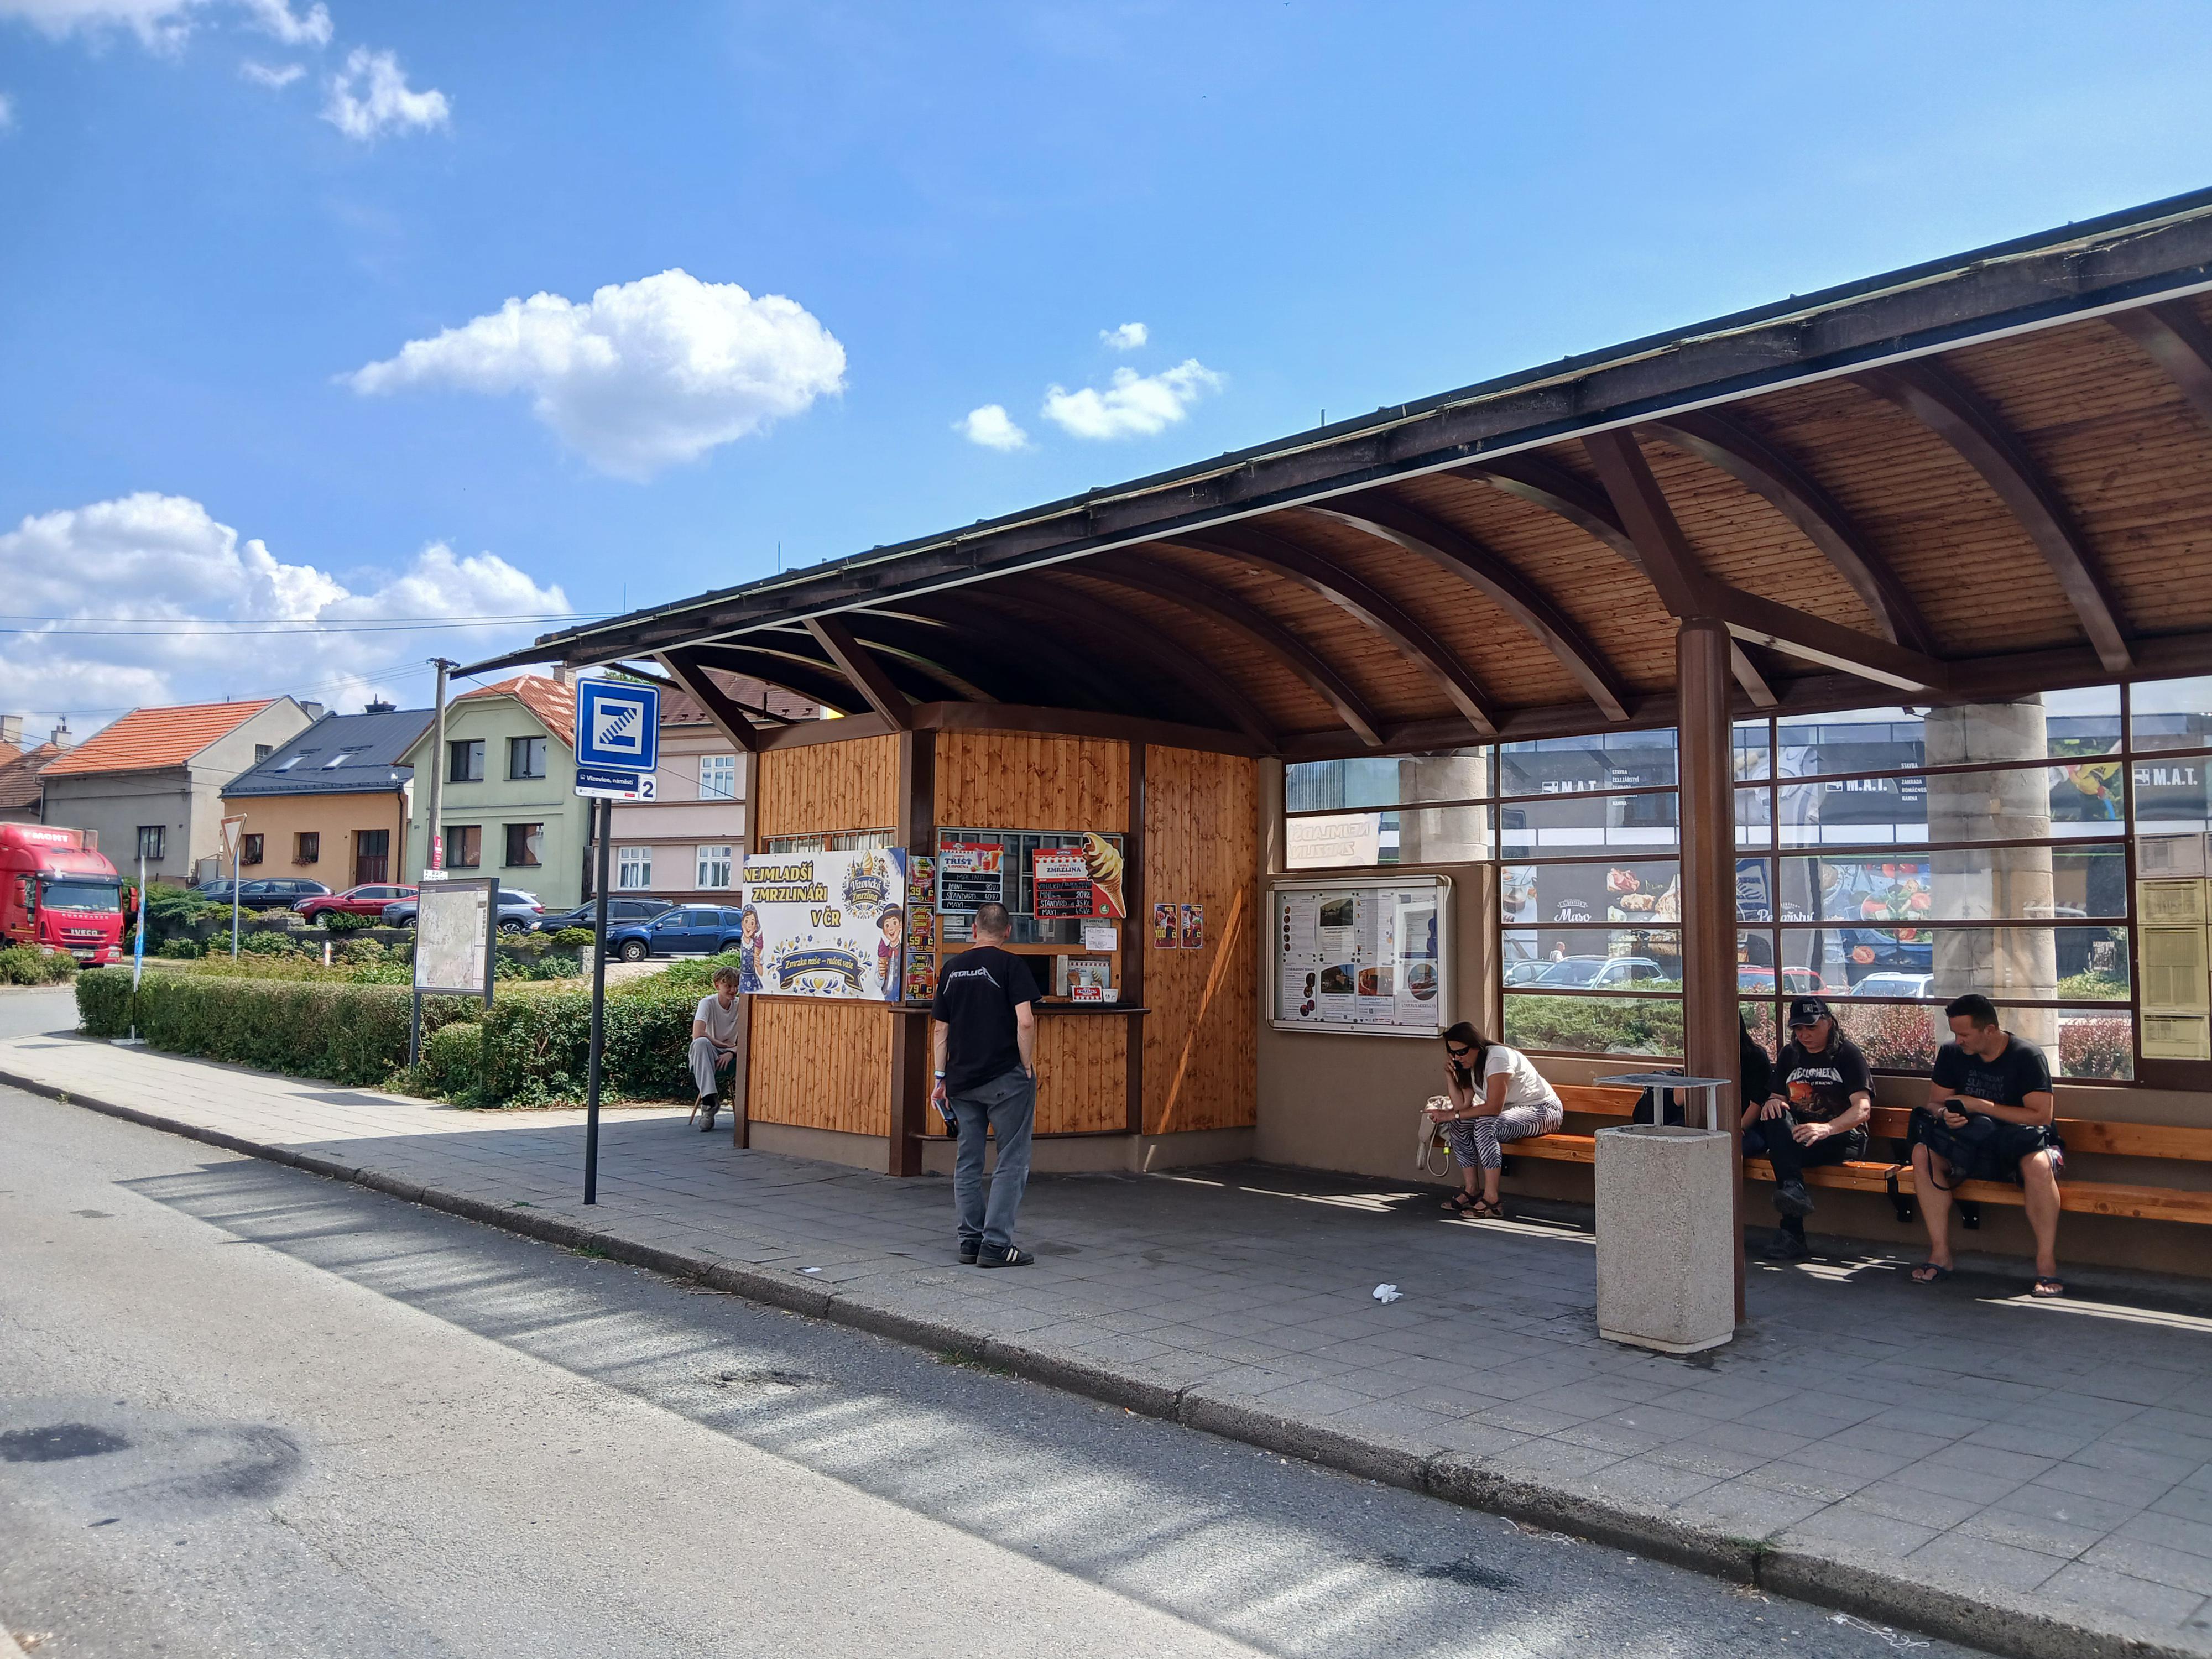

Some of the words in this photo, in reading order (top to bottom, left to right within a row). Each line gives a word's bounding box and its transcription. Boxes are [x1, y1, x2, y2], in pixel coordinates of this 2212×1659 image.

[2153, 768, 2198, 785] M.A.T.
[643, 781, 654, 797] 2
[743, 860, 814, 883] NEJMLADŠÍ
[850, 878, 881, 891] Vizovická
[910, 886, 921, 896] 39
[752, 882, 828, 902] ZMRZLINÁŘI
[852, 890, 878, 902] Zmrzlina
[946, 891, 977, 900] STANDARD
[811, 910, 822, 927] V
[823, 905, 841, 927] ČR
[1554, 908, 1592, 922] Maso
[1757, 909, 1815, 922] Peařství
[909, 936, 920, 945] 59
[785, 957, 807, 969] Zmrzka
[808, 956, 821, 965] naše
[827, 956, 842, 966] radost
[842, 959, 854, 969] vaše
[943, 966, 1001, 994] METALLICA
[909, 984, 919, 993] 79
